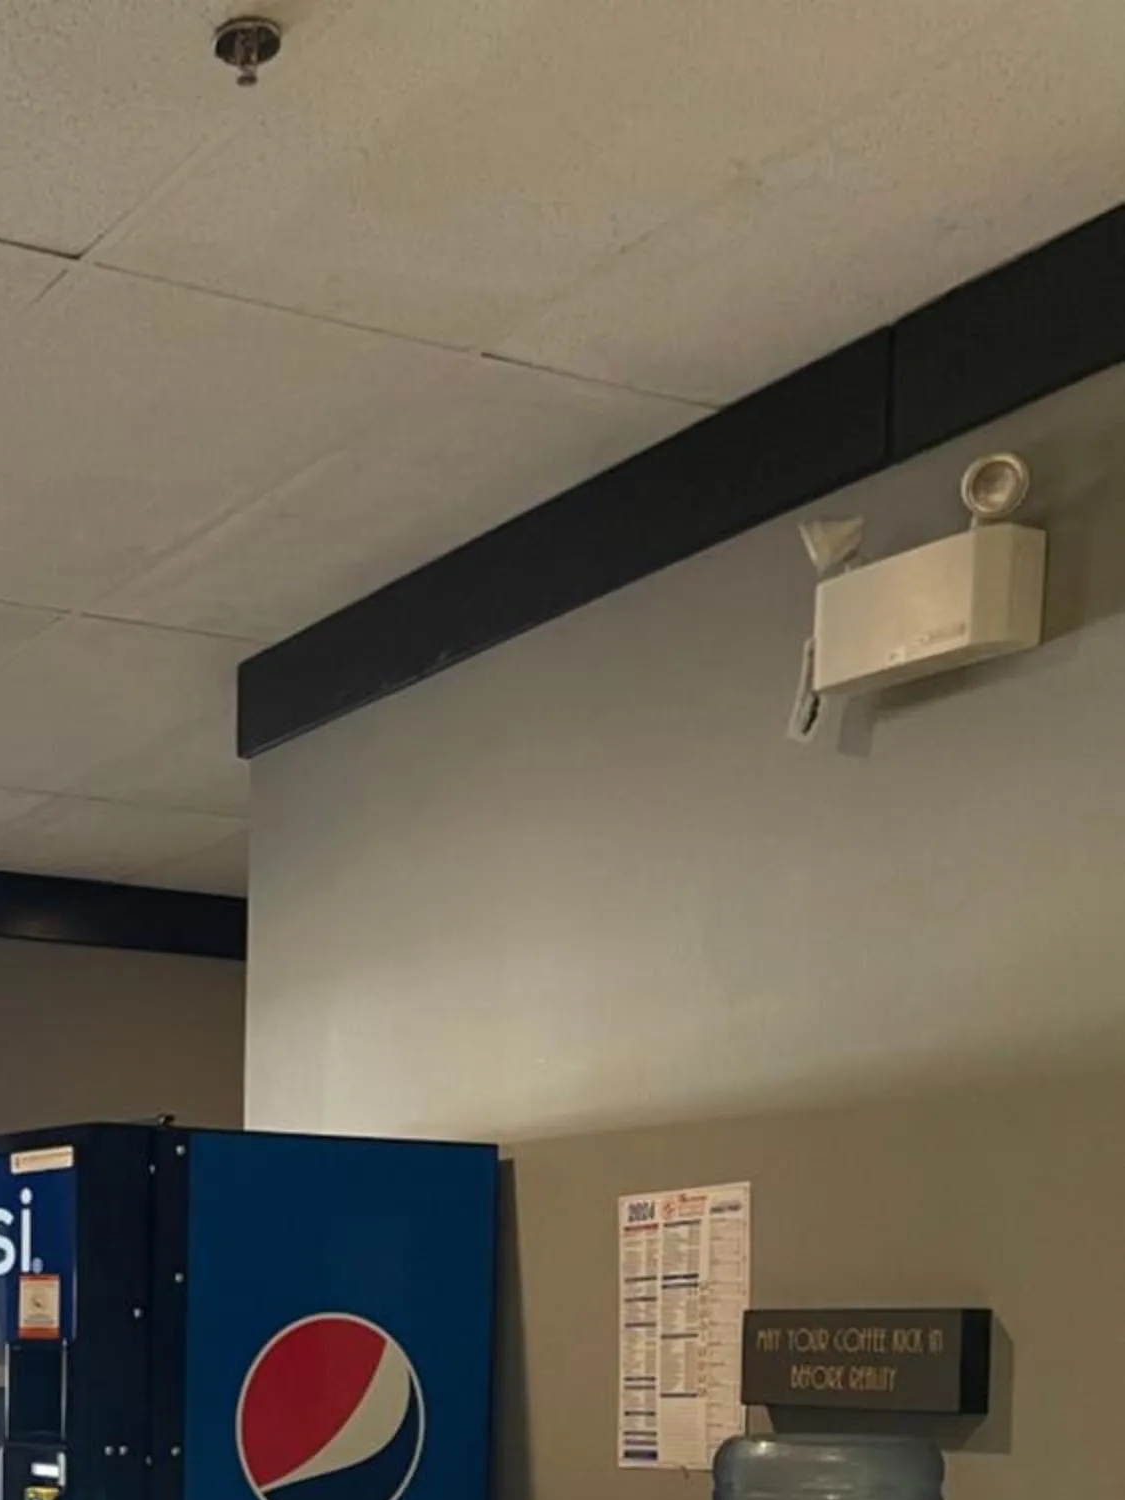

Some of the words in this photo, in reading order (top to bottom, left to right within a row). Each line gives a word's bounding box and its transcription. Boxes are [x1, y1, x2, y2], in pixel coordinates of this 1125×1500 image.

[755, 1328, 781, 1353] MAY
[787, 1327, 830, 1353] YOUR
[833, 1326, 888, 1354] COFFEE
[892, 1327, 924, 1354] KICK
[790, 1364, 845, 1391] BEFORE
